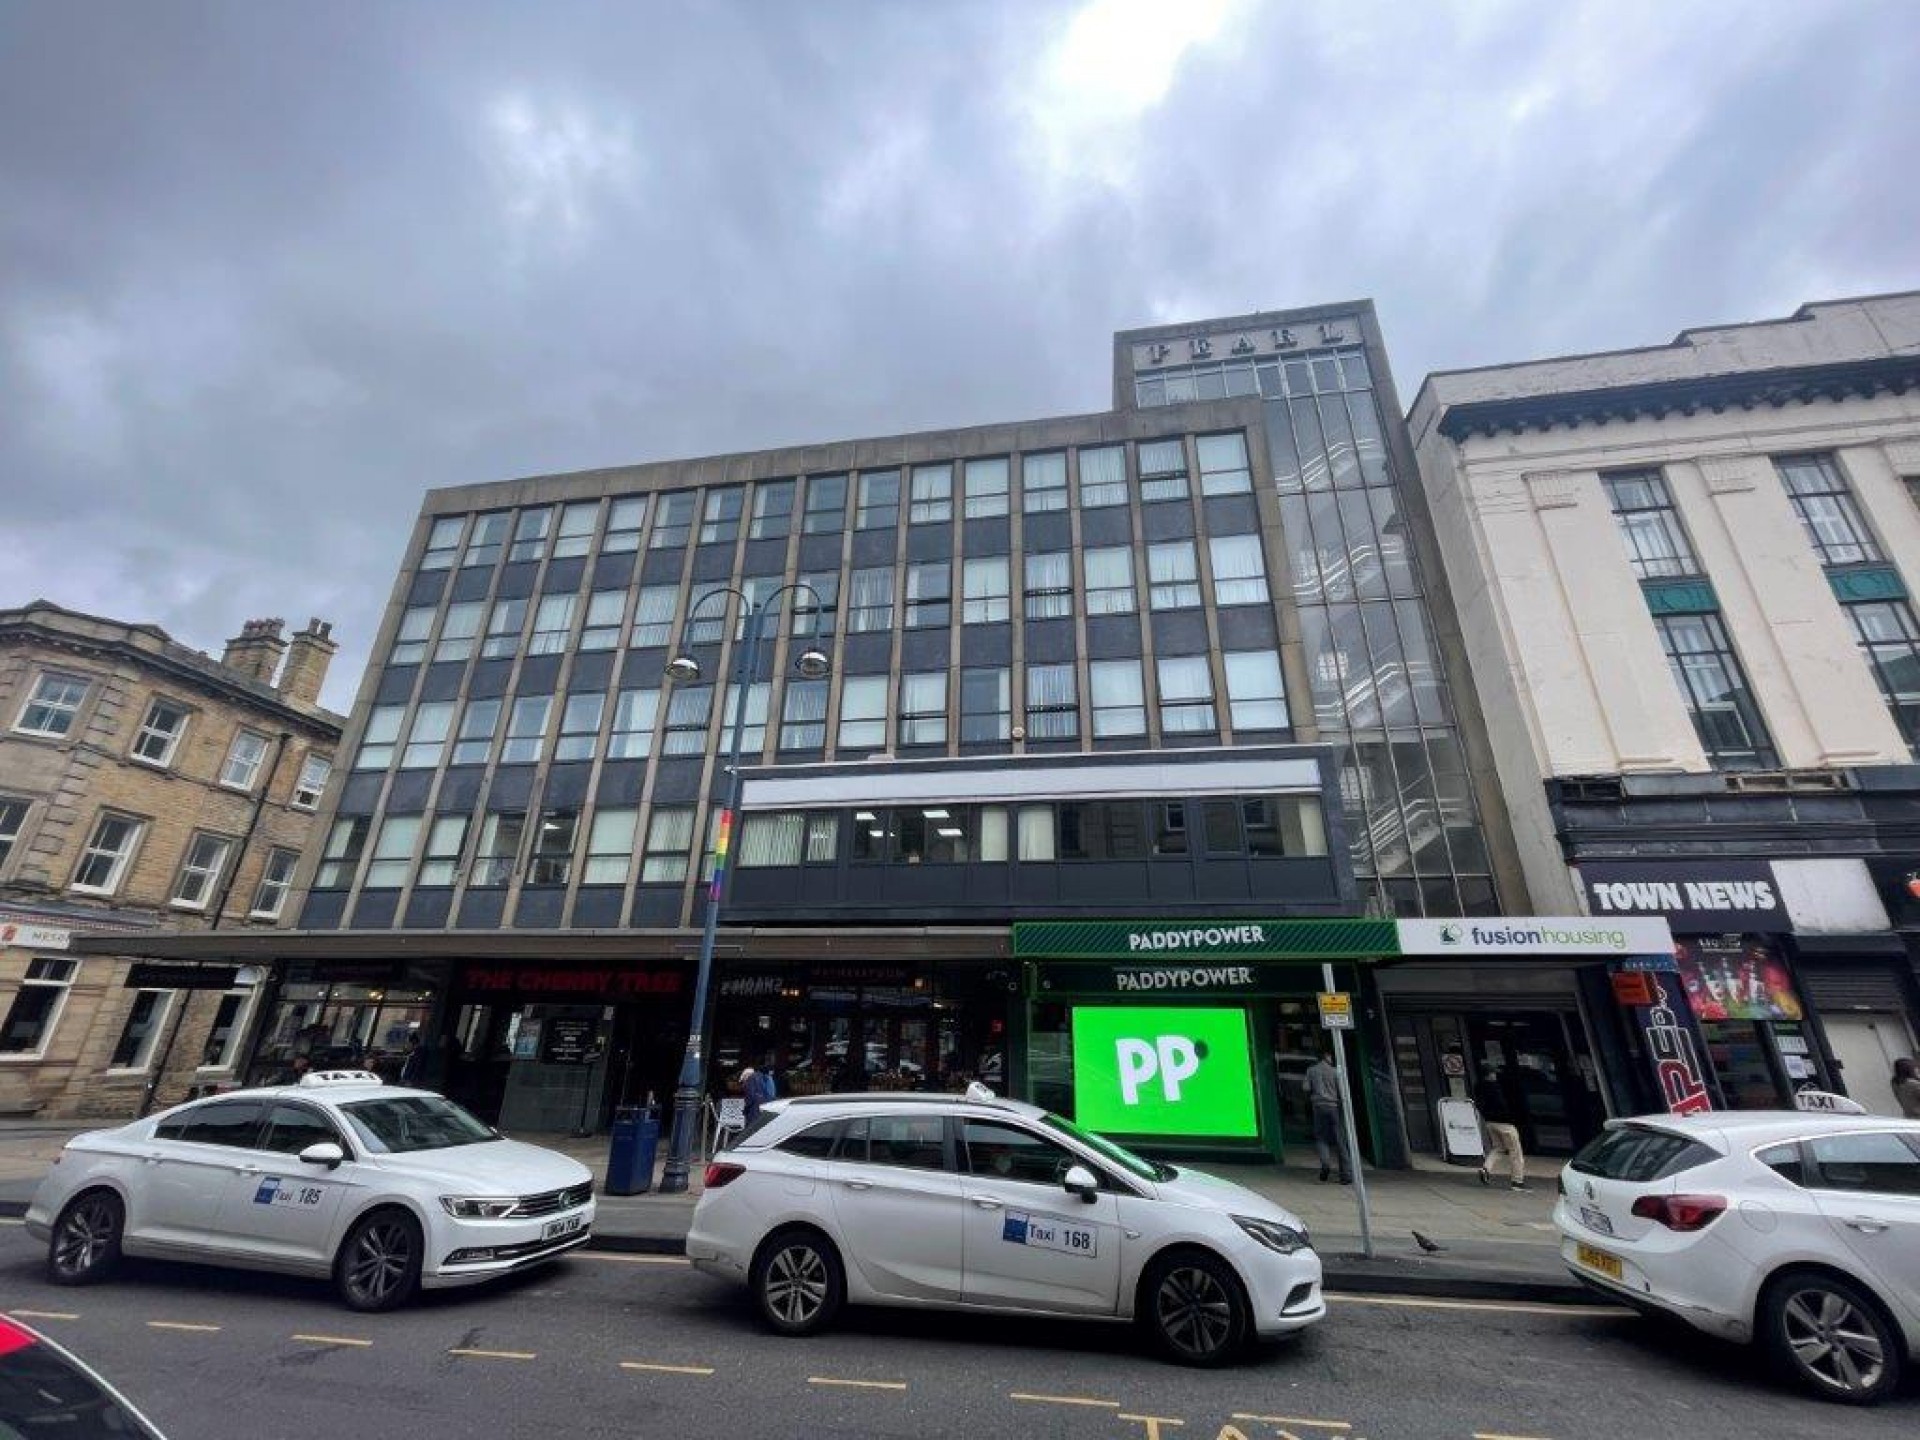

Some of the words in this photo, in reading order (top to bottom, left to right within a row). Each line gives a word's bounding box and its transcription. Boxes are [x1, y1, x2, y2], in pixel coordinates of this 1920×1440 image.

[1149, 321, 1345, 364] PEARL
[1592, 882, 1684, 910] TOWN
[1683, 881, 1777, 910] NEWS
[1128, 925, 1265, 950] PADDYPOWER
[1471, 926, 1626, 949] fusionhousing
[466, 970, 512, 989] THE
[517, 970, 613, 992] CHERRY
[619, 971, 682, 993] TREE
[1116, 967, 1253, 991] PADDYPOWER
[1115, 1035, 1199, 1105] PP
[1797, 1094, 1835, 1109] TAXI
[299, 1188, 322, 1204] 185
[1029, 1223, 1056, 1242] Taxi
[1064, 1229, 1090, 1250] 168
